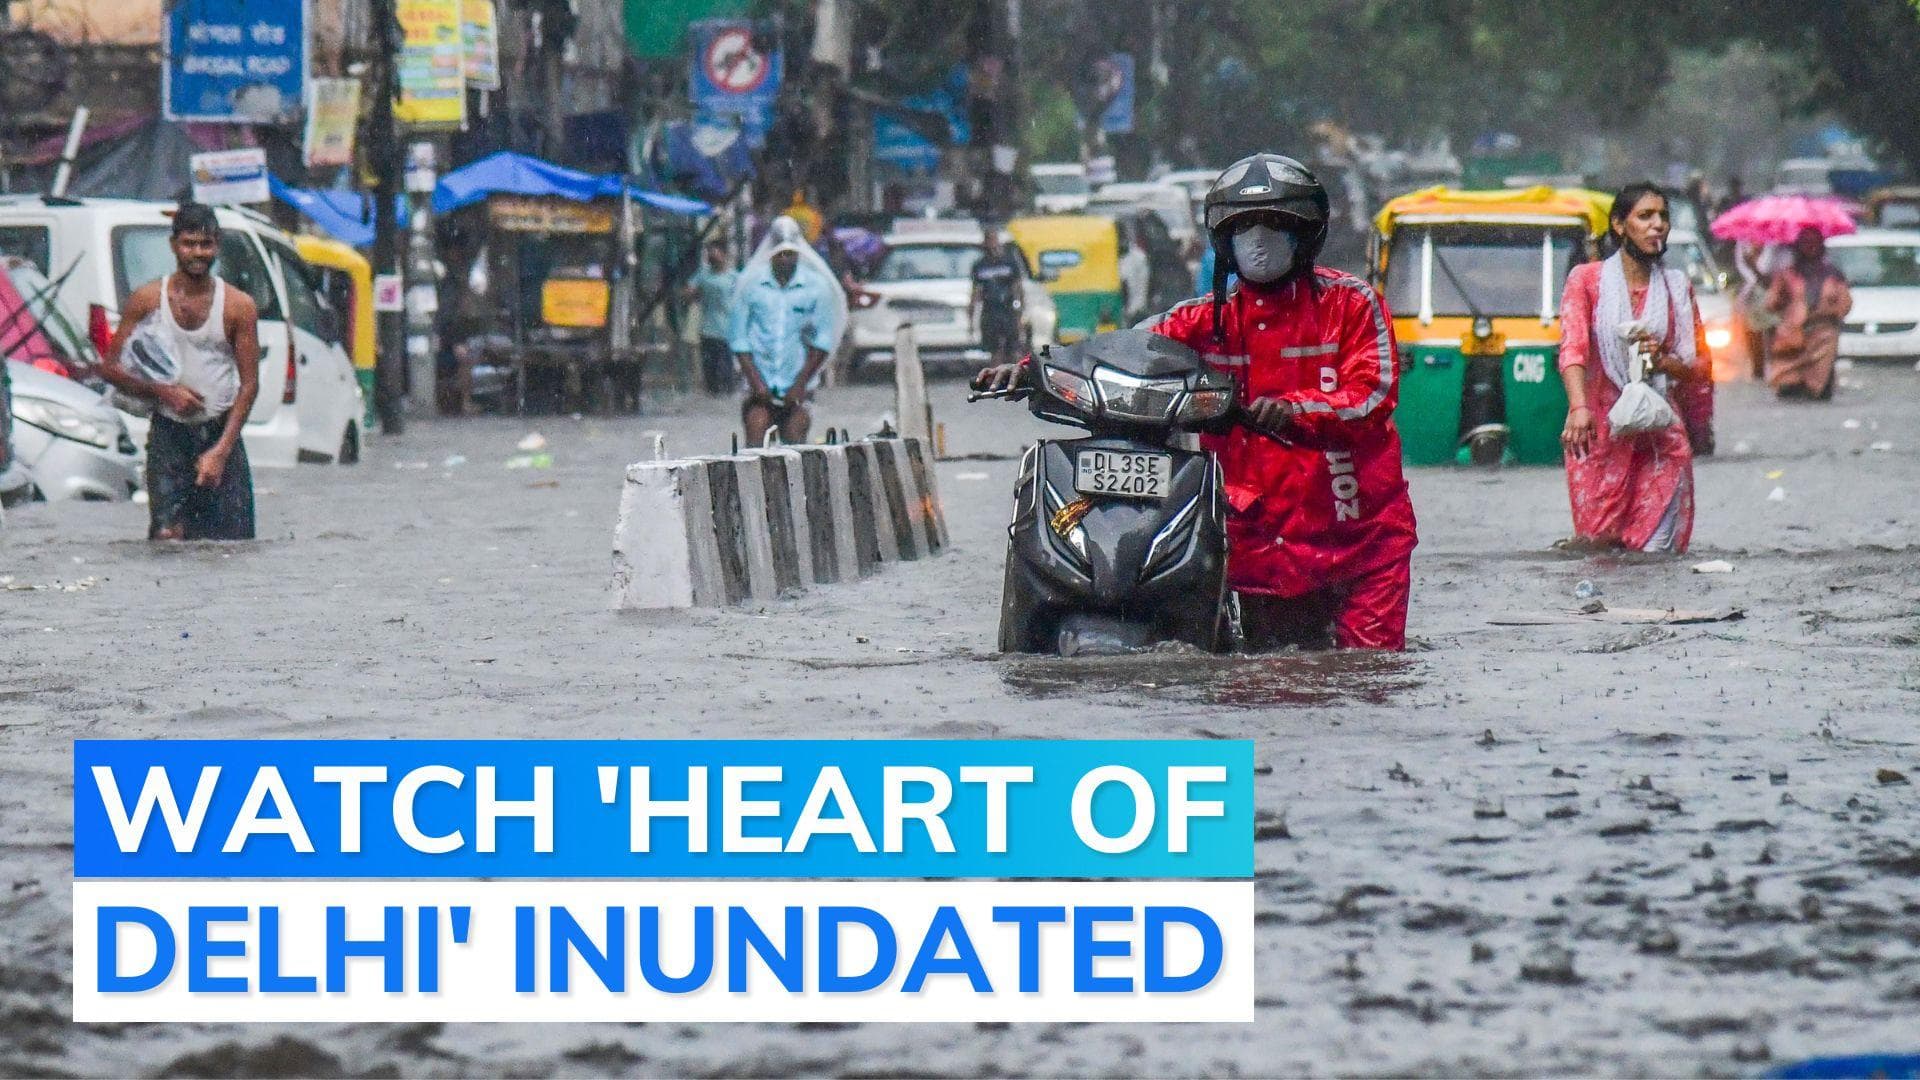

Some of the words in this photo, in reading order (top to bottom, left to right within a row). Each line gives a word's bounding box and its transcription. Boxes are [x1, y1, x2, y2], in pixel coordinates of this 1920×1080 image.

[1513, 353, 1545, 383] CNG
[1094, 453, 1160, 475] DL3SE
[1094, 473, 1158, 495] S2402
